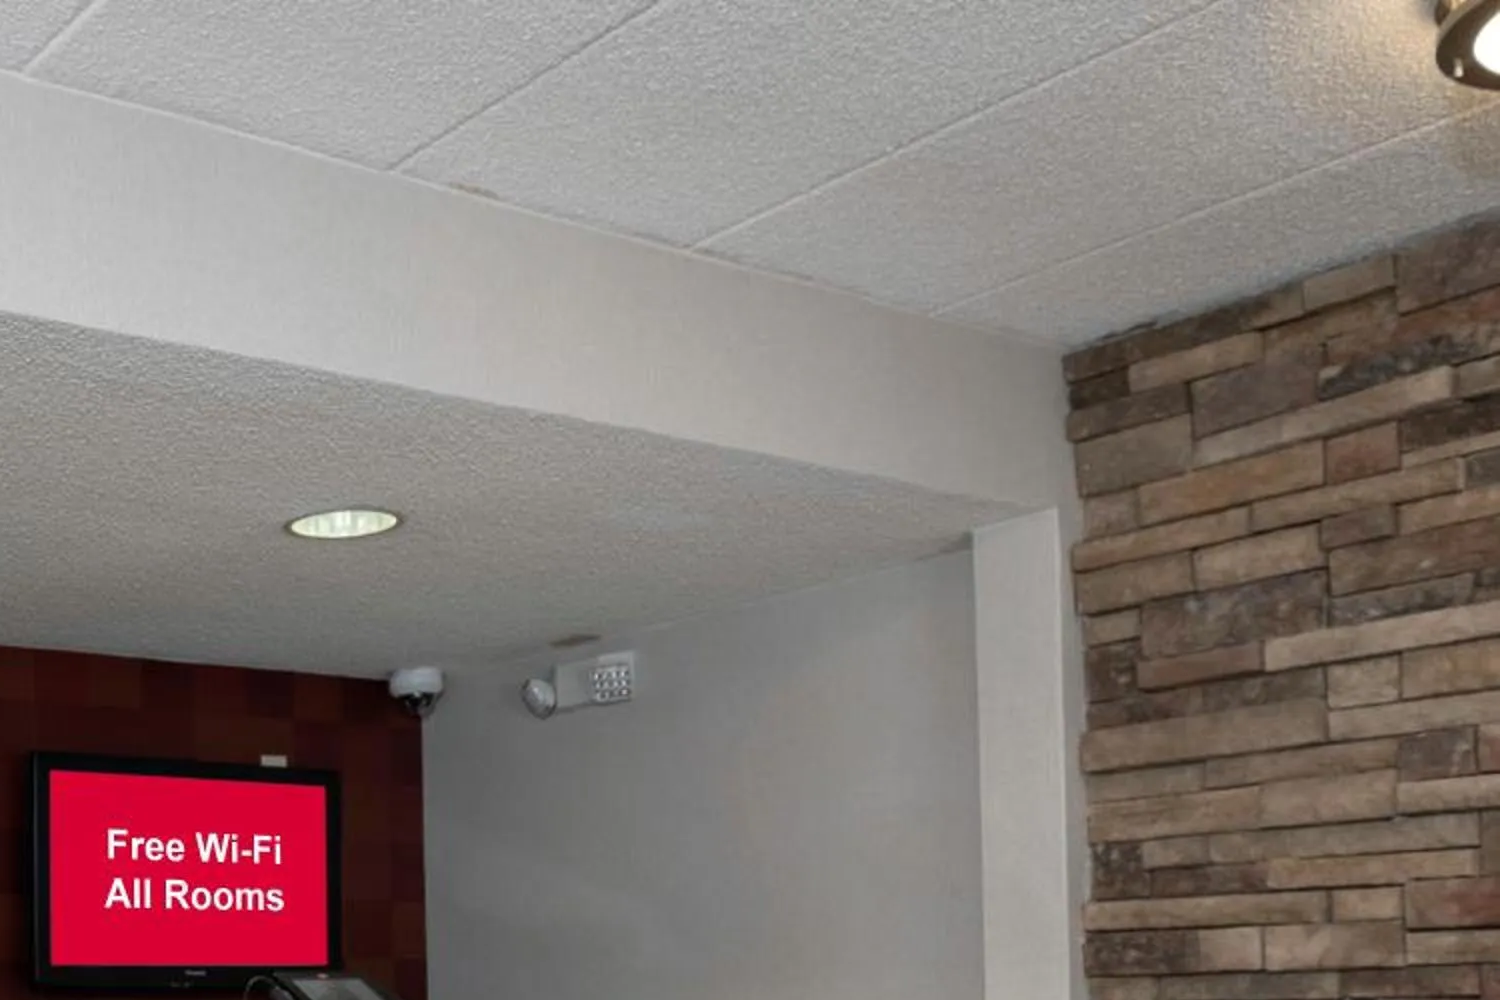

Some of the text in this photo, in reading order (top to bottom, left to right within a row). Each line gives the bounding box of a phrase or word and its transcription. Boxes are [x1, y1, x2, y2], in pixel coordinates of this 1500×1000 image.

[107, 828, 281, 865] Free Wi-Fi
[104, 877, 285, 912] All Rooms
